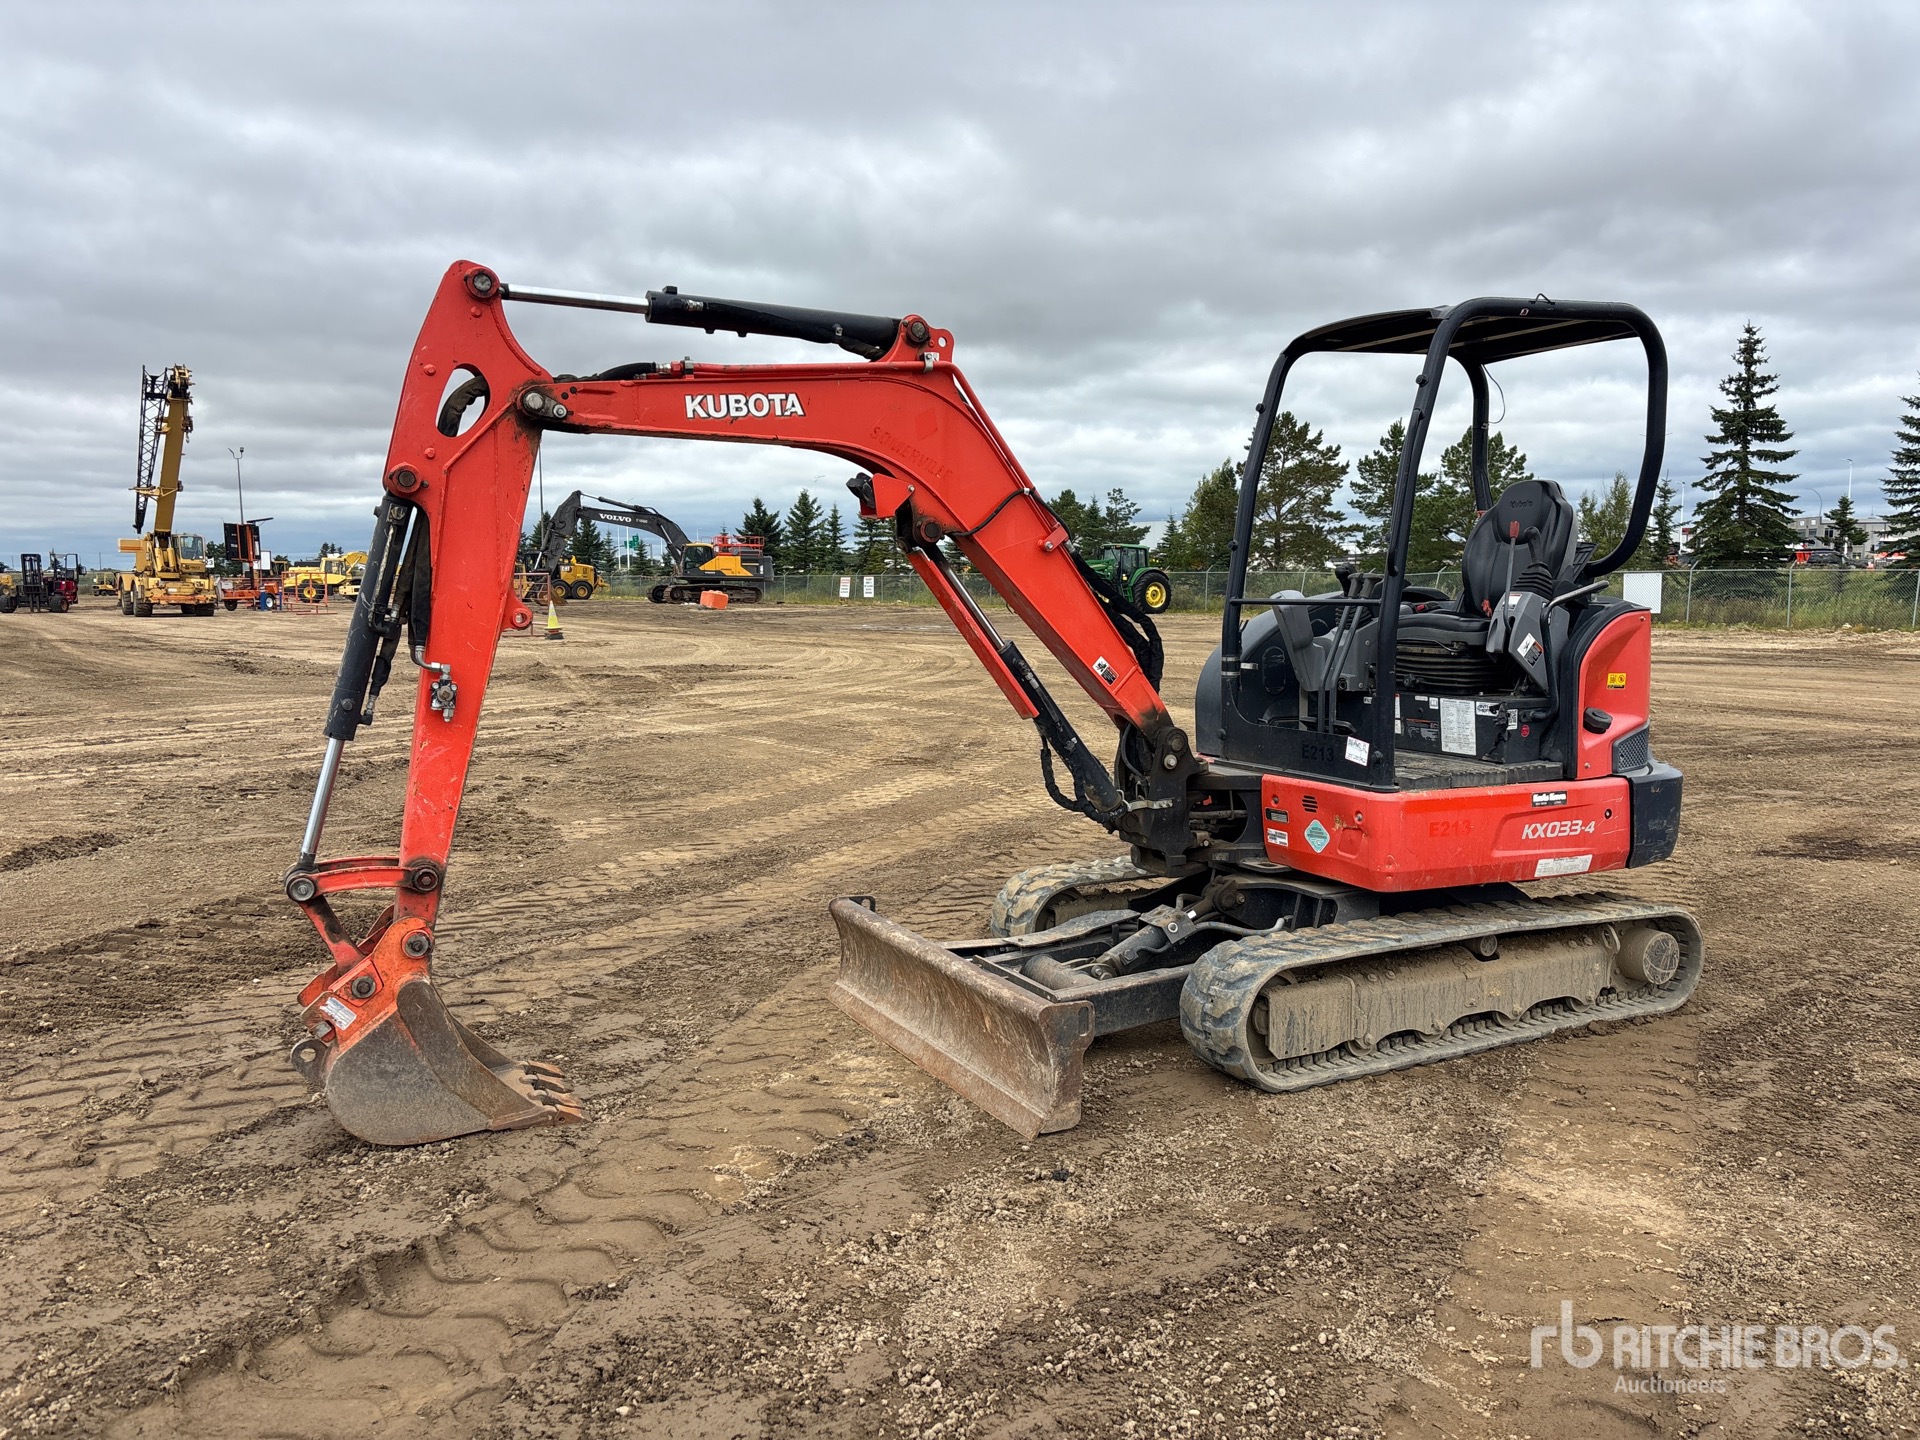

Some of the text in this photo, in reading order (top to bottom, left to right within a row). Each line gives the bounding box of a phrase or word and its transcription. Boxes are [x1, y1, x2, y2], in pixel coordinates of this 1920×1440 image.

[685, 393, 805, 418] KUBOTA
[599, 513, 632, 522] VOLVO
[1301, 743, 1335, 762] E213
[1429, 819, 1472, 838] E213
[1521, 819, 1596, 840] KX033-4
